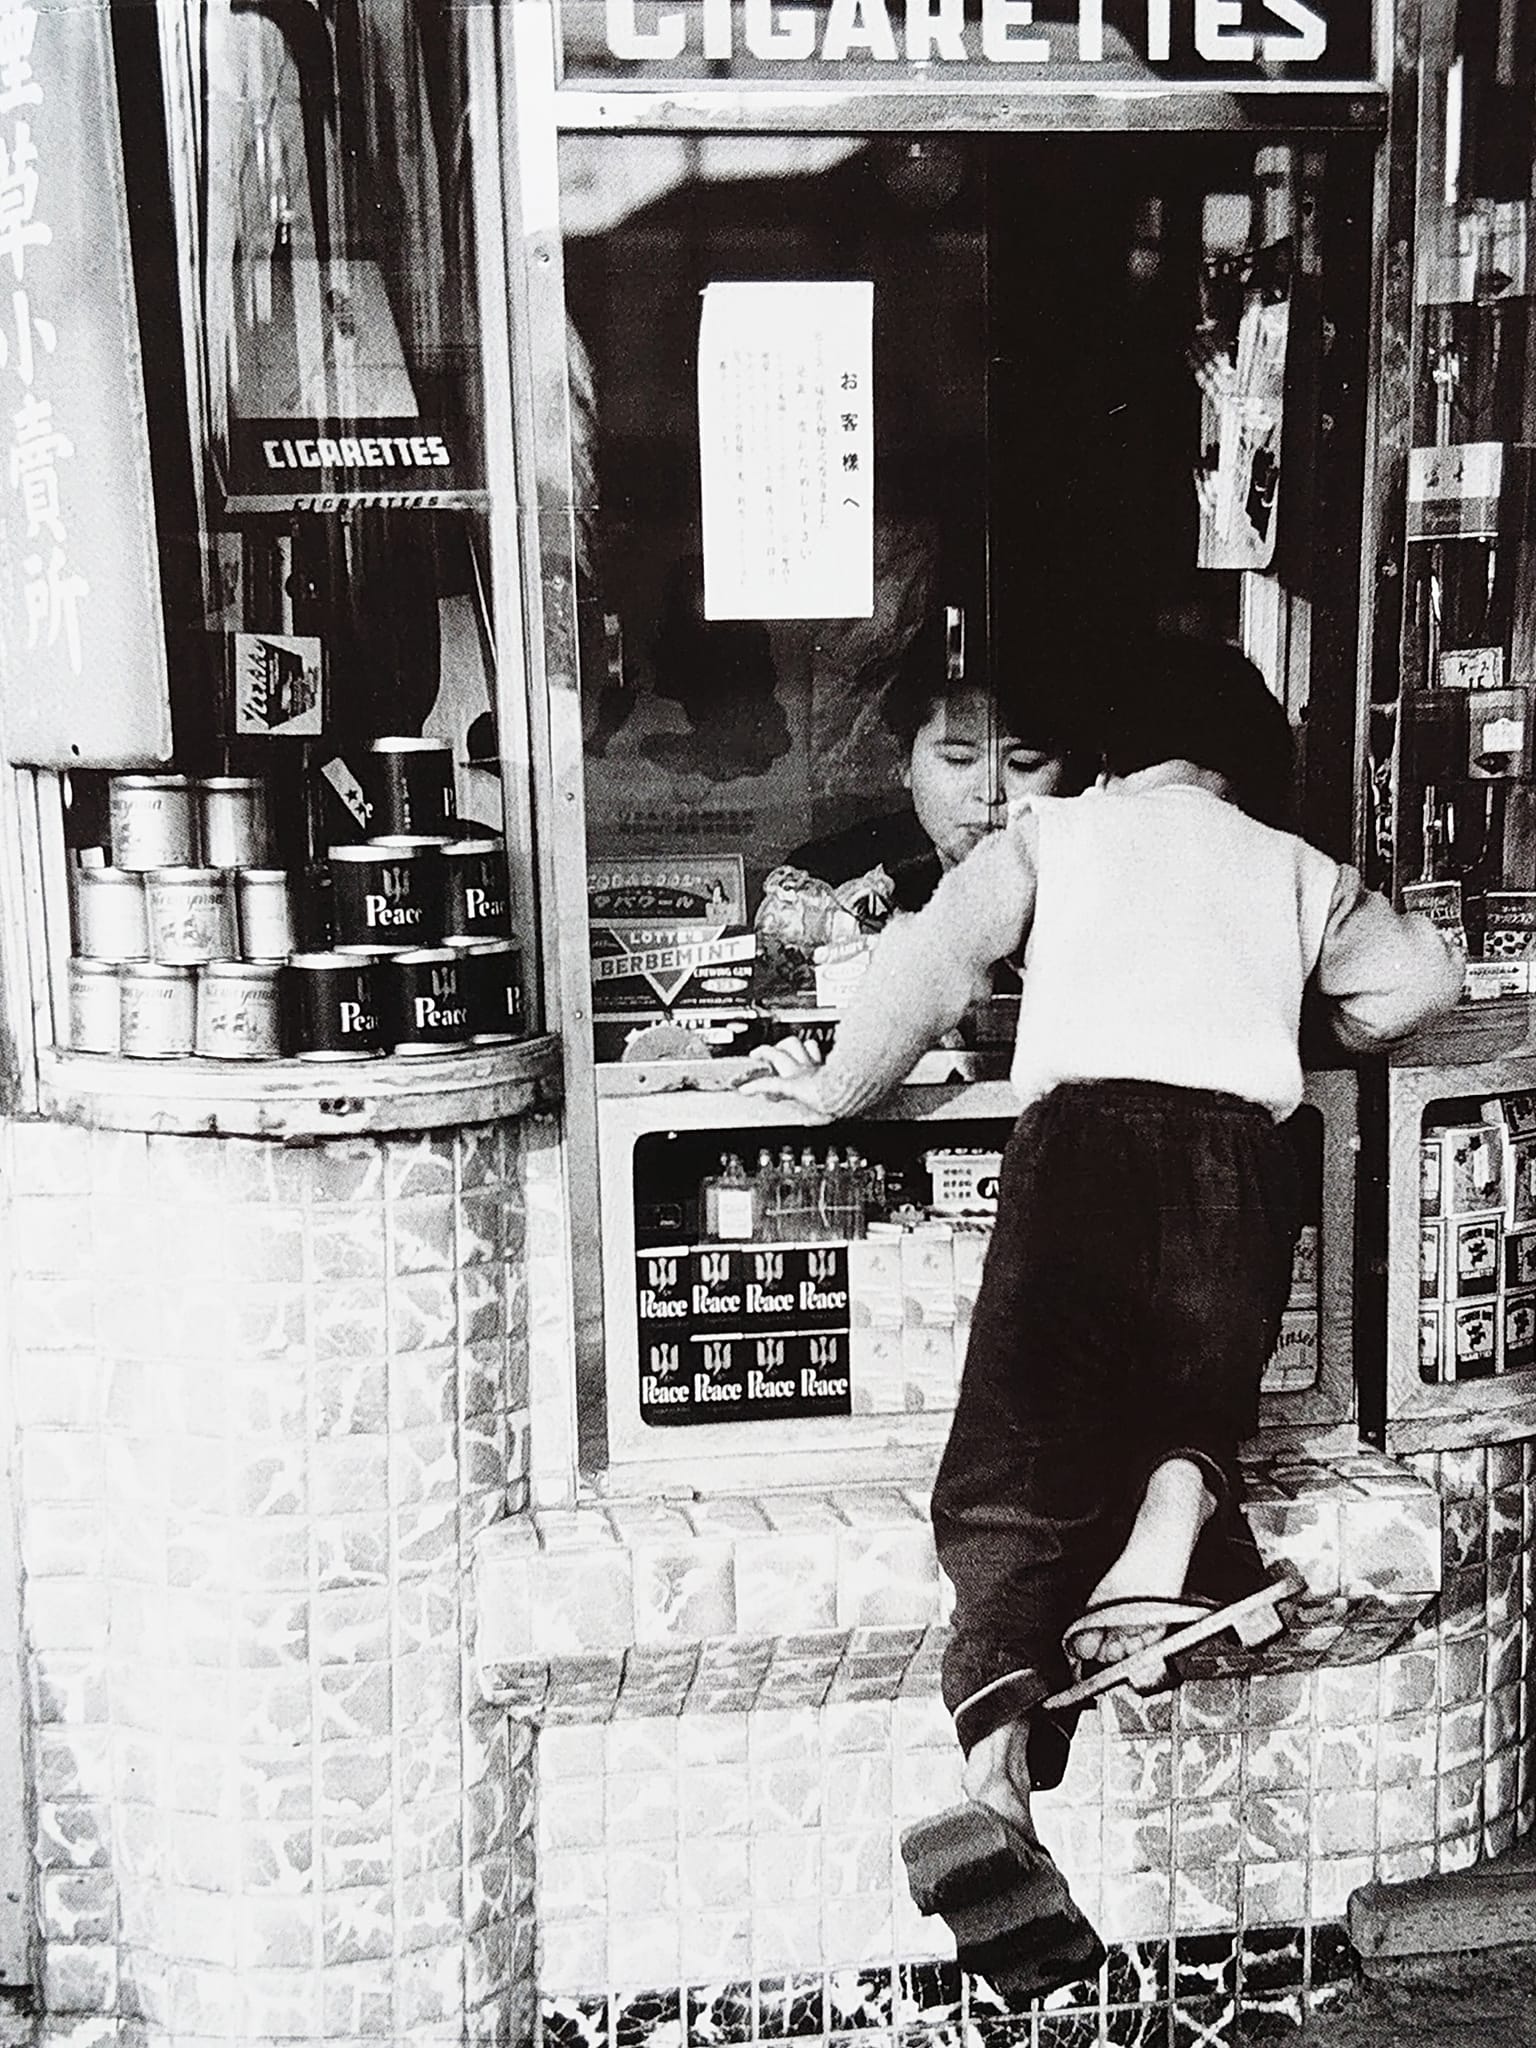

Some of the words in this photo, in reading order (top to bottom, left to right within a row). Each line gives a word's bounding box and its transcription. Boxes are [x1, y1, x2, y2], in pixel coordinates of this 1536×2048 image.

[607, 0, 1327, 61] CIGARETTES
[262, 437, 450, 468] CIGARETTES
[840, 371, 860, 508] お客様へ
[601, 941, 740, 977] BERBEMINT
[640, 1290, 688, 1318] Peace
[692, 1285, 741, 1314] Peace
[746, 1284, 795, 1313] Peace
[800, 1281, 847, 1310] Peace
[642, 1376, 690, 1404] Peace
[694, 1373, 742, 1402] Peace
[747, 1370, 795, 1399] Peace
[801, 1368, 848, 1397] Peace
